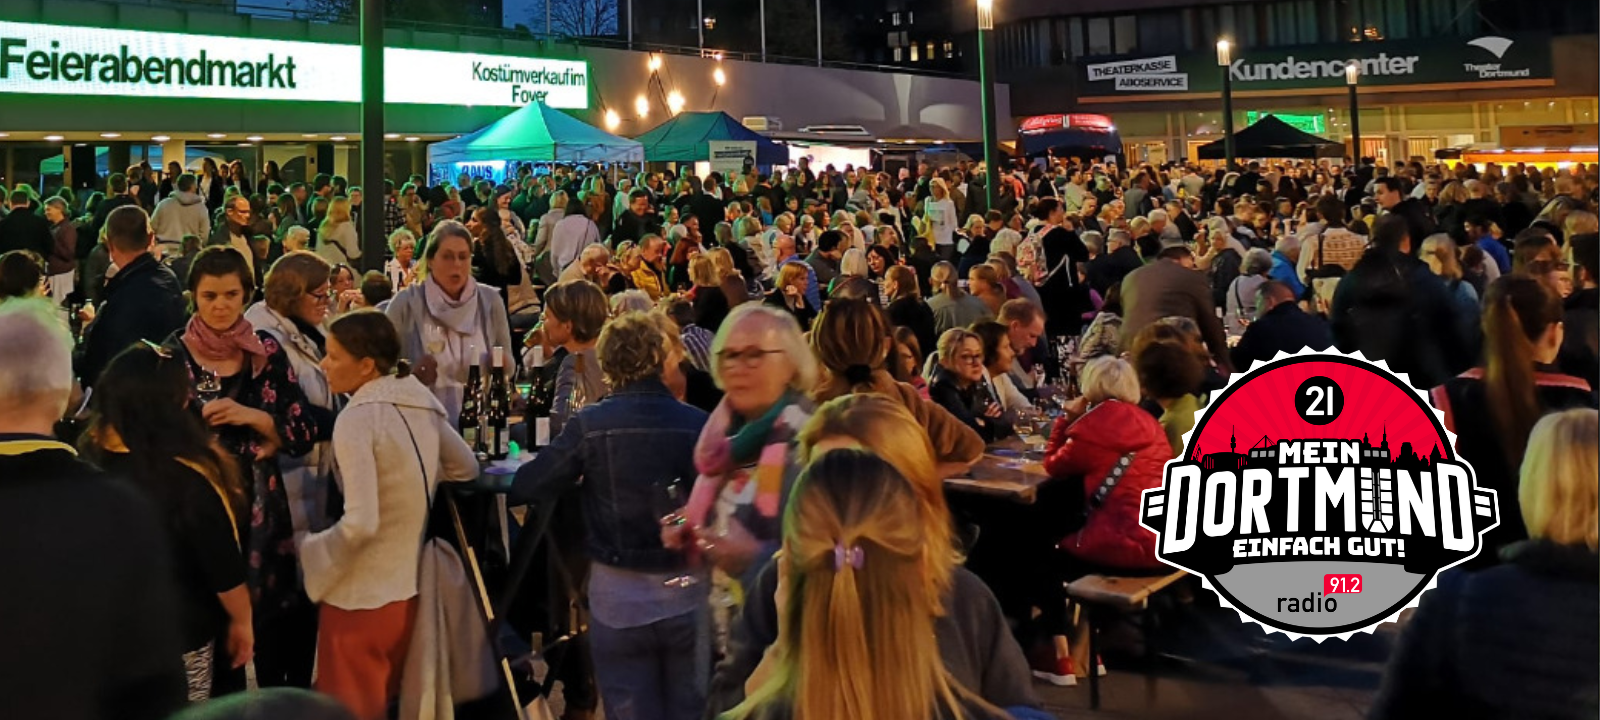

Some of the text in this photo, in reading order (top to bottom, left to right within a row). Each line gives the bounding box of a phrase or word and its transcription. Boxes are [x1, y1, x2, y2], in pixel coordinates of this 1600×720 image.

[0, 37, 297, 89] Feierabendmarkt
[1092, 60, 1172, 77] THEATERKASSE
[1463, 63, 1501, 72] Theater
[1479, 68, 1530, 78] Dortmund
[1119, 77, 1184, 88] ABOSERVICE
